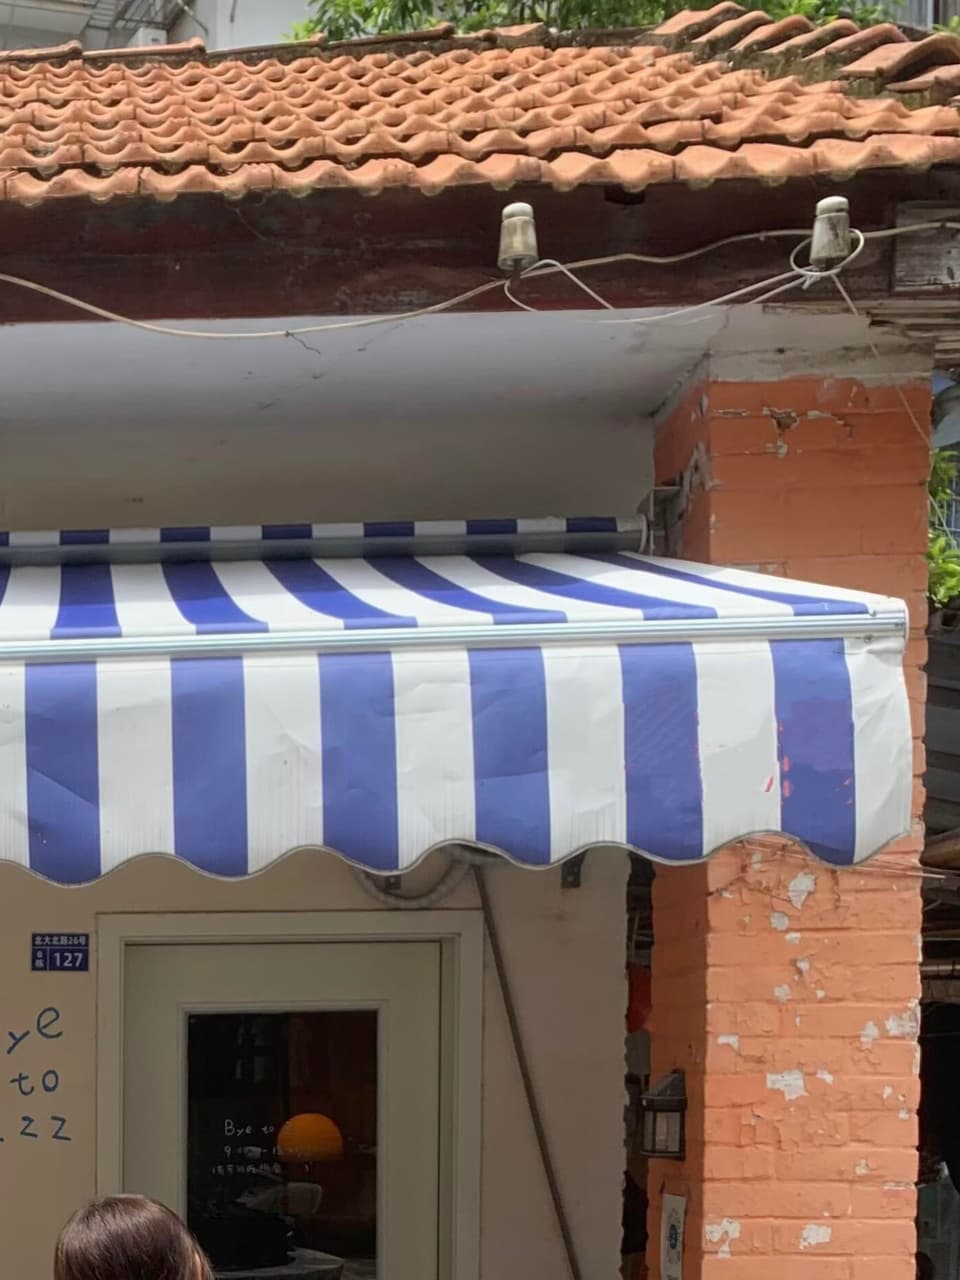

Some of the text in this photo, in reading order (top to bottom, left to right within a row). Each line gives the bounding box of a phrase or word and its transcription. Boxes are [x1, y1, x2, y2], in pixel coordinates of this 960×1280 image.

[53, 952, 83, 967] 127
[9, 1069, 60, 1096] to
[225, 1119, 253, 1137] Bye
